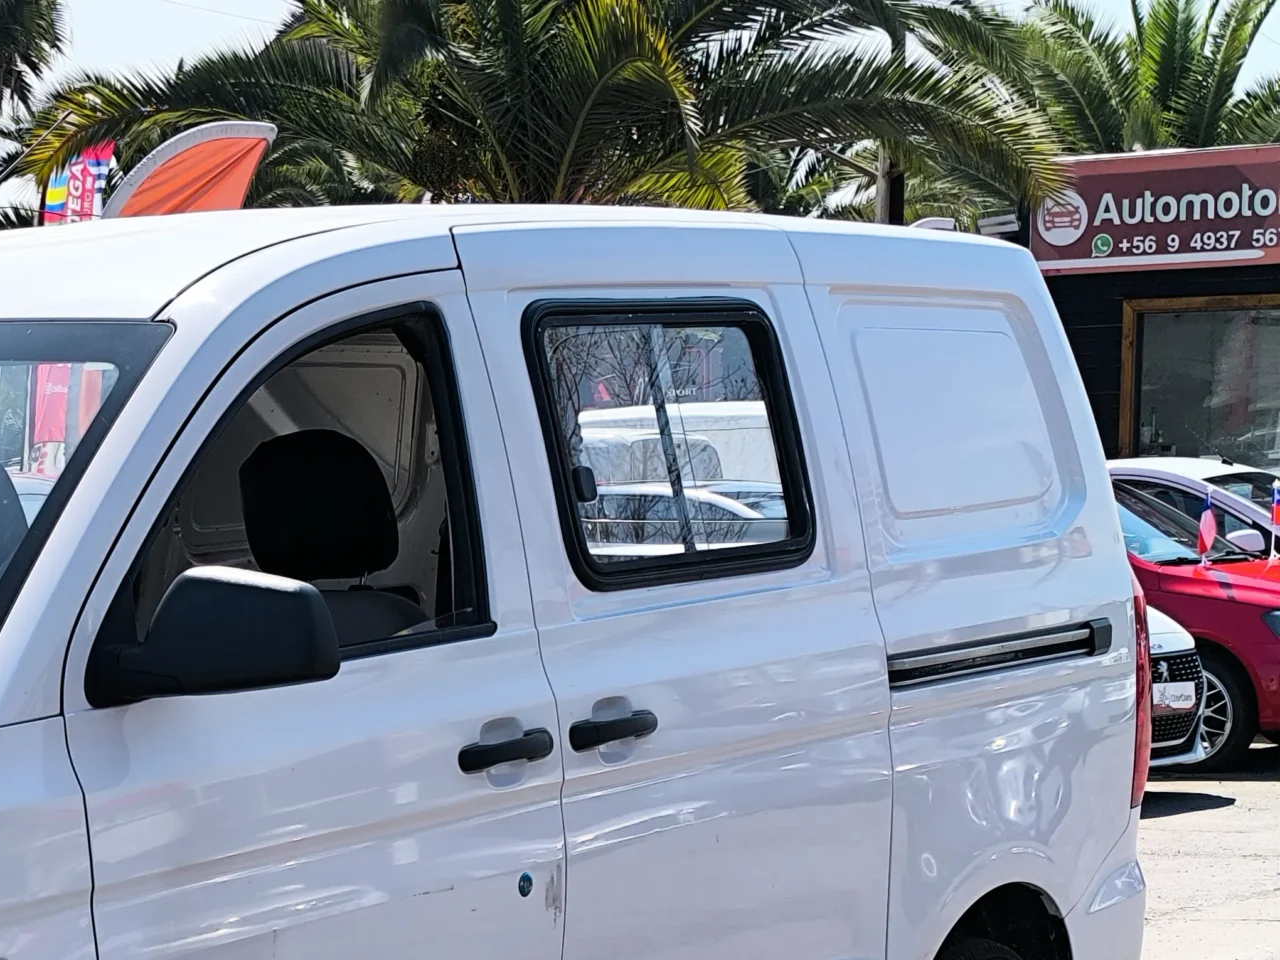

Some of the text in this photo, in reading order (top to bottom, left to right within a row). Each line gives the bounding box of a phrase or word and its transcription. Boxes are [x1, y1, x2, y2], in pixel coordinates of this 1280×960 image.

[1093, 183, 1280, 227] Automoto
[1118, 228, 1280, 254] +56 9 4937 56
